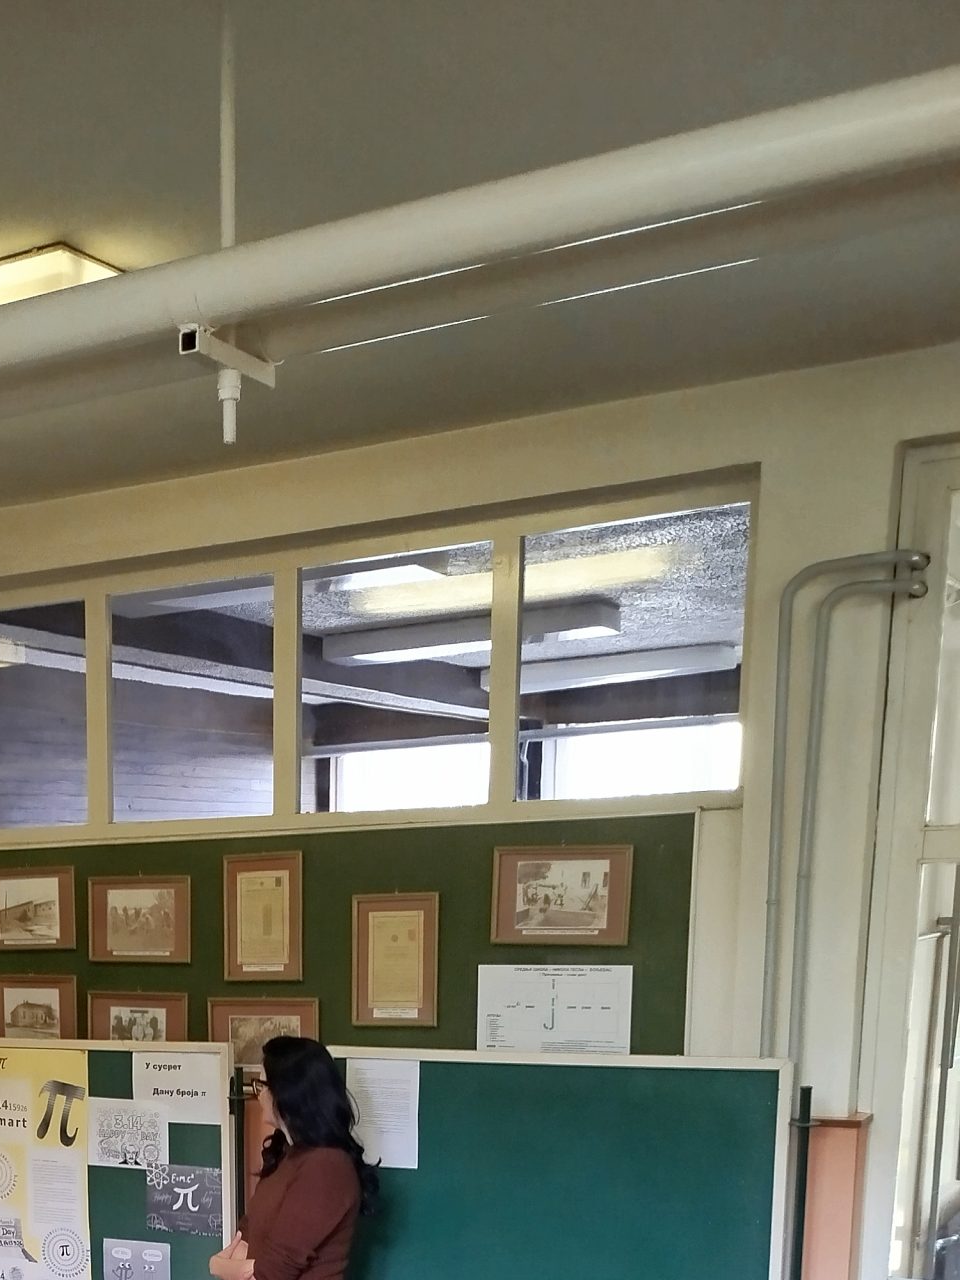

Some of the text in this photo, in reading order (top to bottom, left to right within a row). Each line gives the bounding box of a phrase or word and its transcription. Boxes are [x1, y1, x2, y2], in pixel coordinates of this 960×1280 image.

[152, 1064, 182, 1072] сусрет
[152, 1087, 174, 1097] Дану
[176, 1088, 199, 1098] броја
